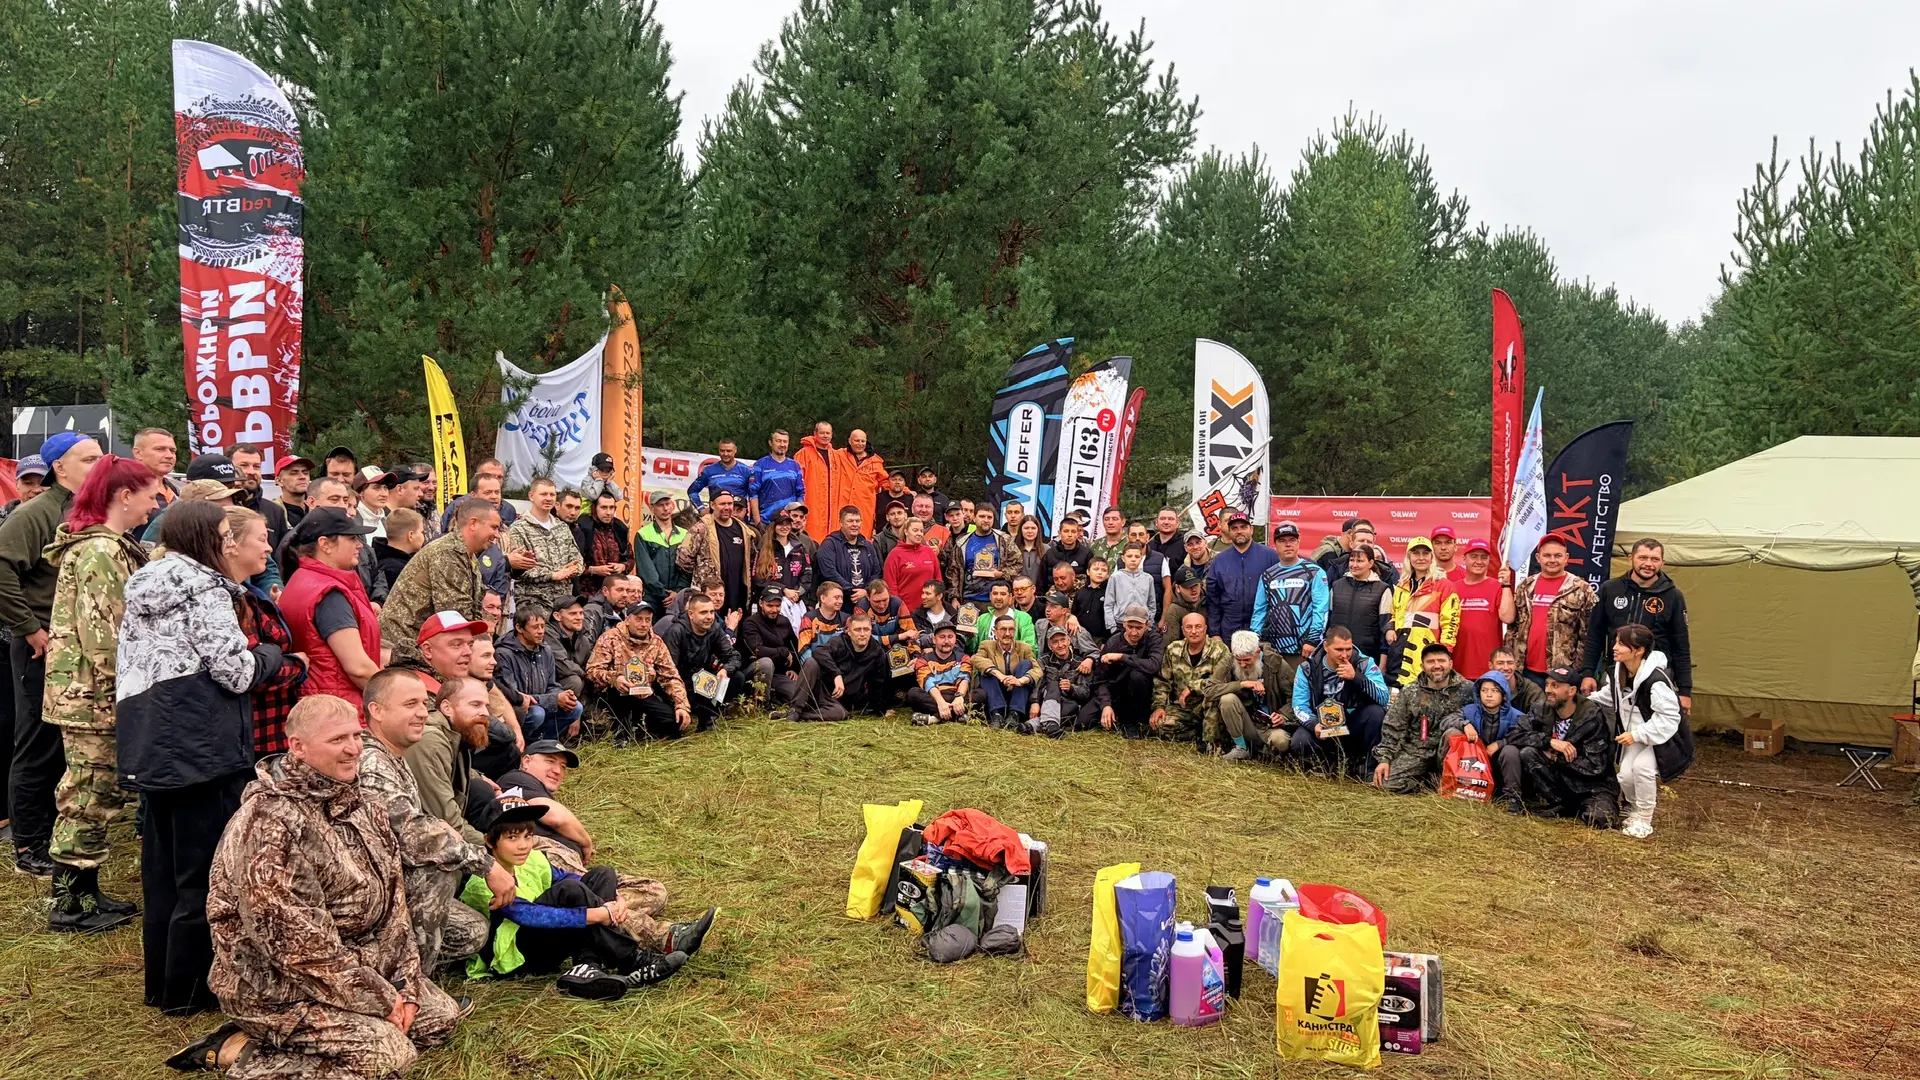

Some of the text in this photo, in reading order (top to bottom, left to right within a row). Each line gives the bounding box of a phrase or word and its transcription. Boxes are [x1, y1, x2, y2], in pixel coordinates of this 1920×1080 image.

[1017, 408, 1033, 474] DIFFER
[1079, 426, 1101, 461] 63
[1276, 509, 1301, 517] OILWAY
[1332, 510, 1358, 518] OILWAY
[1390, 511, 1418, 519] OILWAY
[1451, 511, 1479, 519] OILWAY
[1591, 473, 1612, 566] АГЕНТСТВО
[1297, 1018, 1355, 1034] КАНИСТРА
